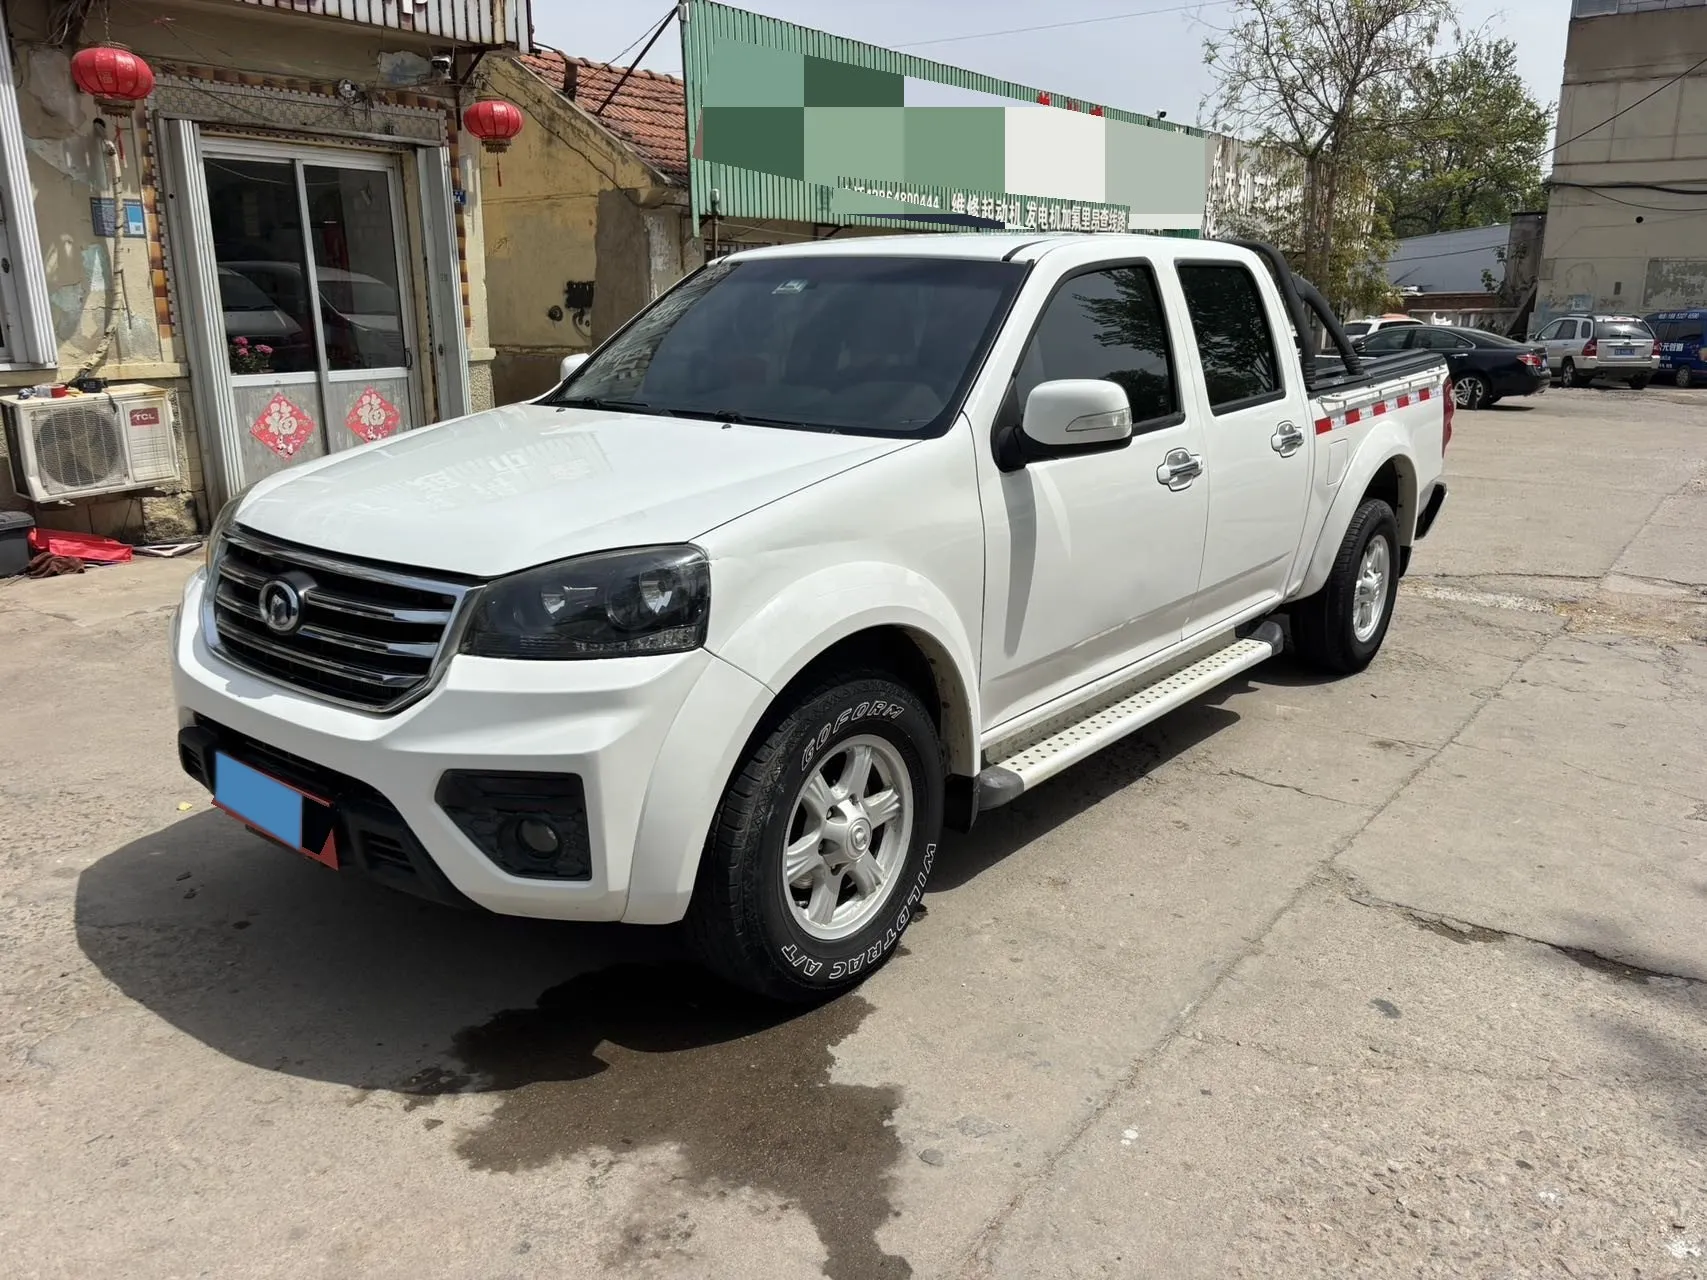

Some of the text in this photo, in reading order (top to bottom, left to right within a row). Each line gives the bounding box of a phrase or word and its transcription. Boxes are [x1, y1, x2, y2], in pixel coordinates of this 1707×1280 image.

[132, 412, 155, 421] TCL
[265, 400, 298, 436] 福
[356, 393, 386, 426] 福
[801, 700, 905, 771] GOFORM
[781, 843, 937, 979] WILDTRAC A/T
